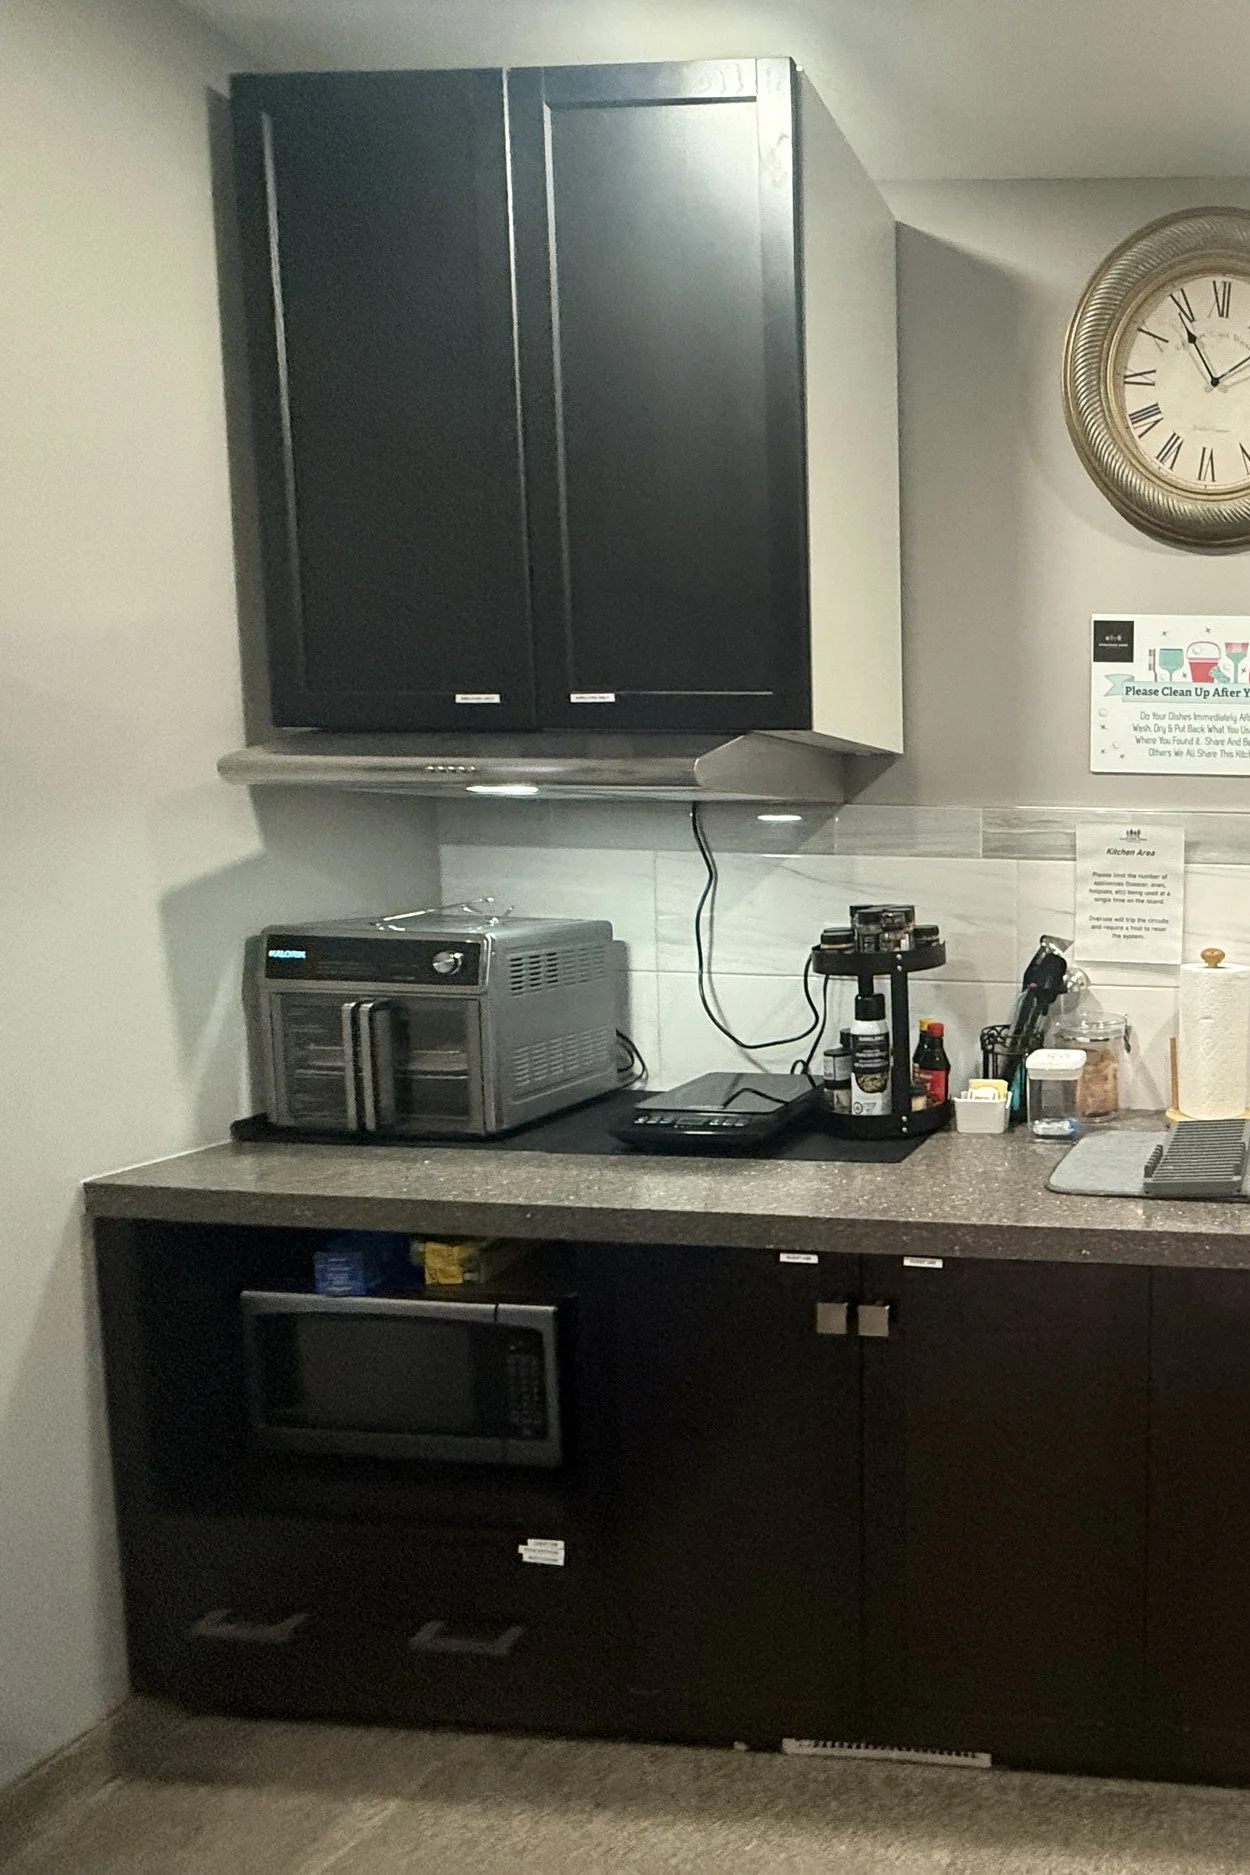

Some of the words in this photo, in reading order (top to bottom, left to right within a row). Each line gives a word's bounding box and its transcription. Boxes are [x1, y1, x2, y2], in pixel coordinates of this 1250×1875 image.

[1124, 686, 1160, 696] Please
[1162, 686, 1192, 697] Clean
[1194, 687, 1210, 699] Up
[1212, 688, 1242, 698] After
[1140, 710, 1150, 720] Do
[1152, 711, 1166, 720] Your
[1168, 711, 1192, 721] Dishes
[1193, 712, 1238, 724] Immediately
[1153, 723, 1166, 735] Dry
[1174, 724, 1186, 733] Put
[1187, 724, 1205, 733] Back
[1206, 724, 1225, 734] What
[1227, 725, 1239, 734] You
[1134, 735, 1158, 744] Where
[1159, 736, 1171, 745] You
[1172, 736, 1194, 746] Found
[1205, 736, 1225, 746] Share
[1227, 737, 1241, 746] And
[1148, 748, 1172, 757] Others
[1173, 748, 1184, 757] We
[1186, 748, 1196, 758] All
[1197, 748, 1218, 758] Share
[1219, 749, 1234, 758] This
[1106, 848, 1136, 856] Kitchen
